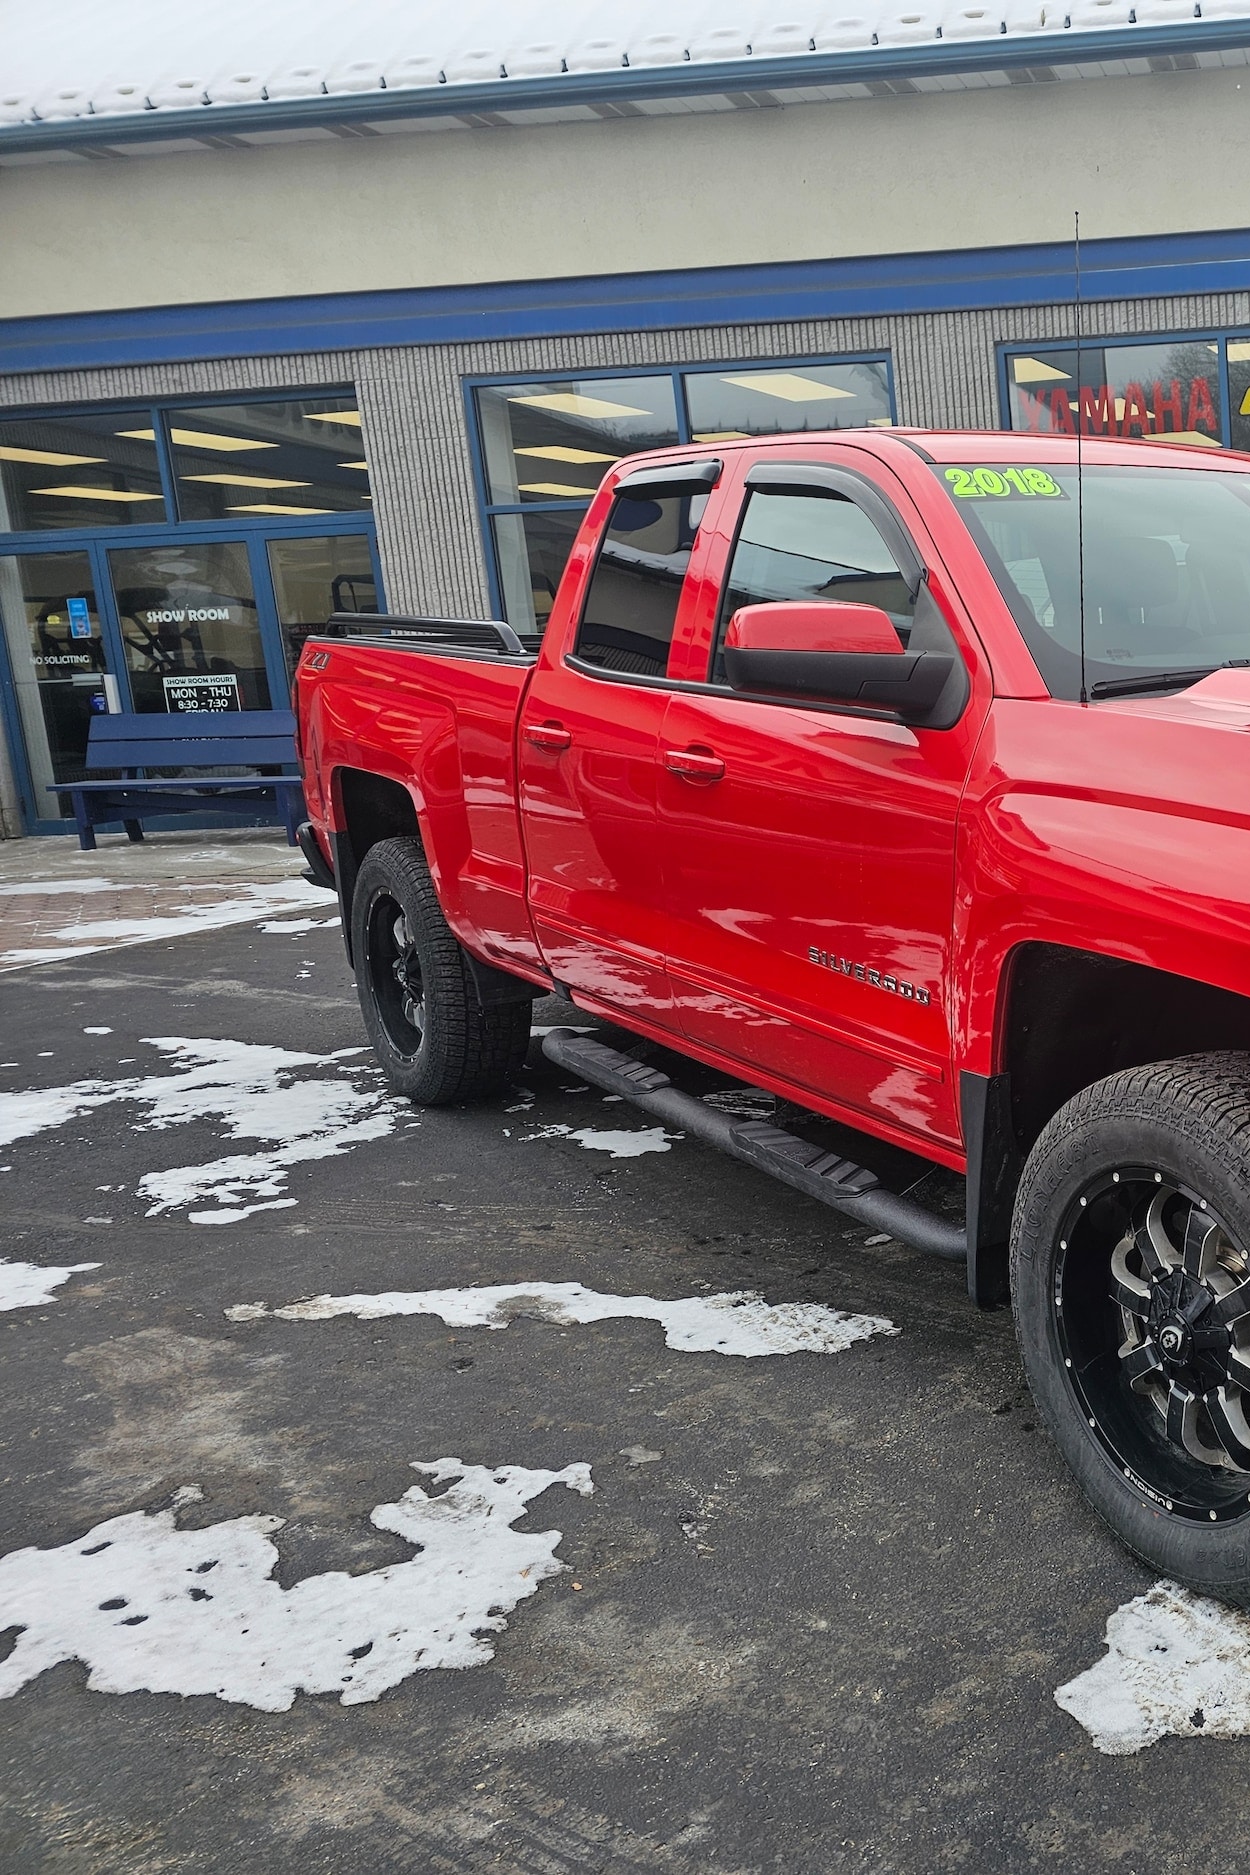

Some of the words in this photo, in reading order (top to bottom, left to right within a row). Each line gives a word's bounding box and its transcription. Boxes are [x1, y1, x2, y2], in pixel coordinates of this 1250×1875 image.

[1018, 376, 1217, 437] YAMAHA
[944, 467, 1061, 498] 2018
[146, 610, 185, 623] SHOW
[187, 608, 230, 622] ROOM
[30, 656, 43, 665] NO
[44, 655, 90, 665] SOLICITING
[301, 651, 331, 669] Z71
[170, 688, 198, 698] MON
[209, 686, 232, 697] THU
[178, 700, 198, 709] 8:30
[207, 699, 228, 708] 7:30
[808, 946, 931, 1006] SILVERADO
